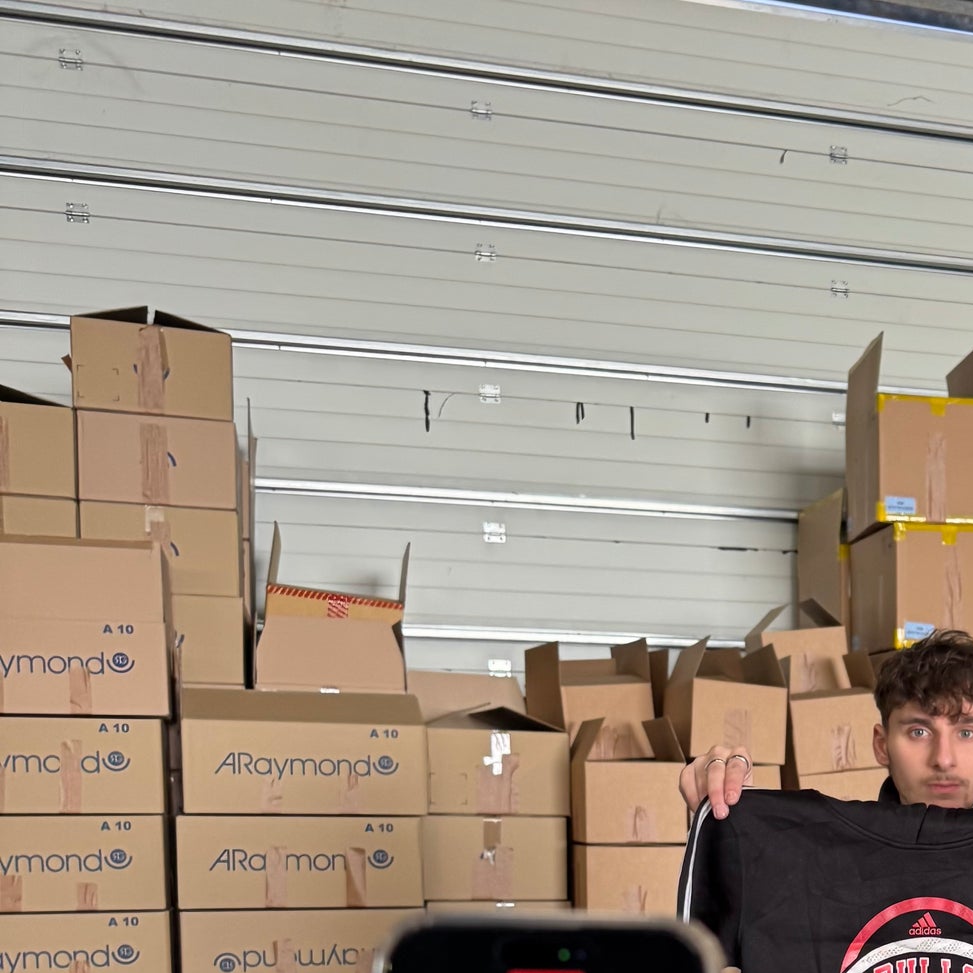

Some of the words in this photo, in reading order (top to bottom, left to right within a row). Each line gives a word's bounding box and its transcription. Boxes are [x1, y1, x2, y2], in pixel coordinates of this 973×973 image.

[103, 624, 113, 634] A
[117, 624, 134, 634] 10
[99, 723, 108, 733] A
[113, 723, 130, 733] 10
[369, 729, 379, 738] A
[384, 729, 399, 739] 10
[214, 752, 371, 780] ARaymond
[101, 821, 111, 831] A
[115, 821, 131, 831] 10
[365, 823, 374, 832] A
[379, 823, 394, 833] 10
[209, 849, 350, 872] ARamon
[108, 917, 118, 927] A
[123, 917, 139, 927] 10
[908, 926, 942, 936] adidas
